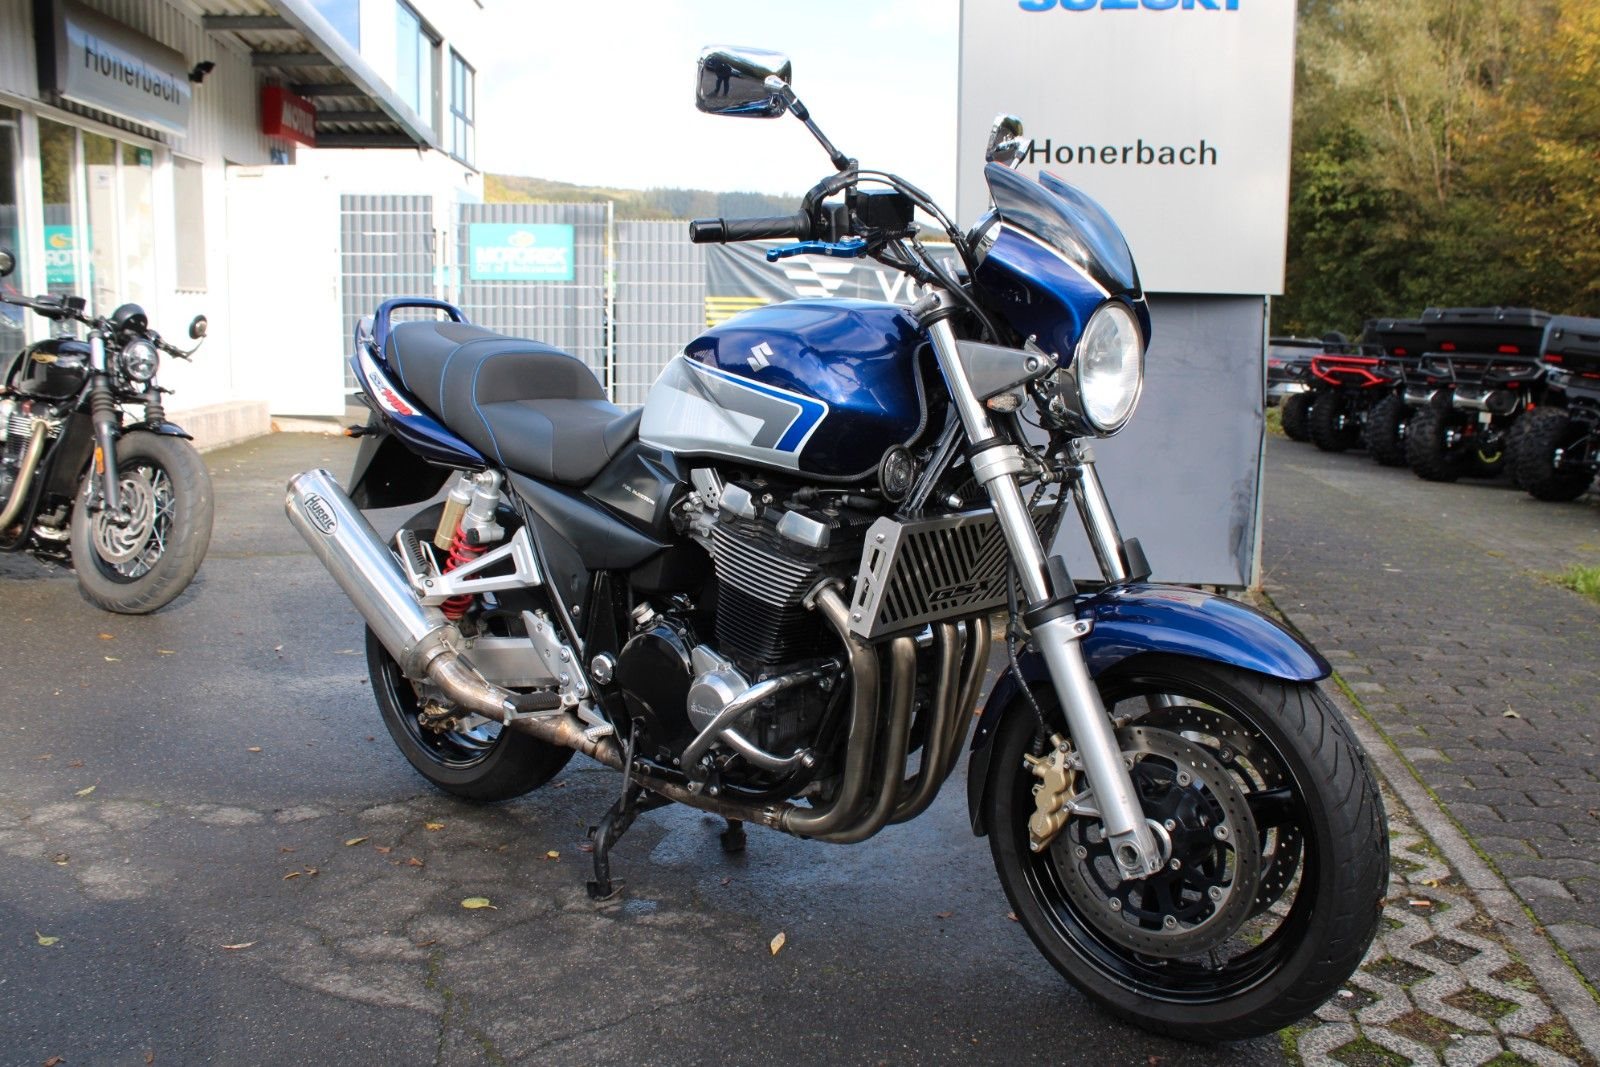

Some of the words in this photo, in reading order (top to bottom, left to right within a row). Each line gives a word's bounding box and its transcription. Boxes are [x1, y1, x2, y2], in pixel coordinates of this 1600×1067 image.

[83, 33, 182, 105] Honerbach
[1029, 139, 1217, 165] Honerbach
[305, 494, 336, 529] HURRIC
